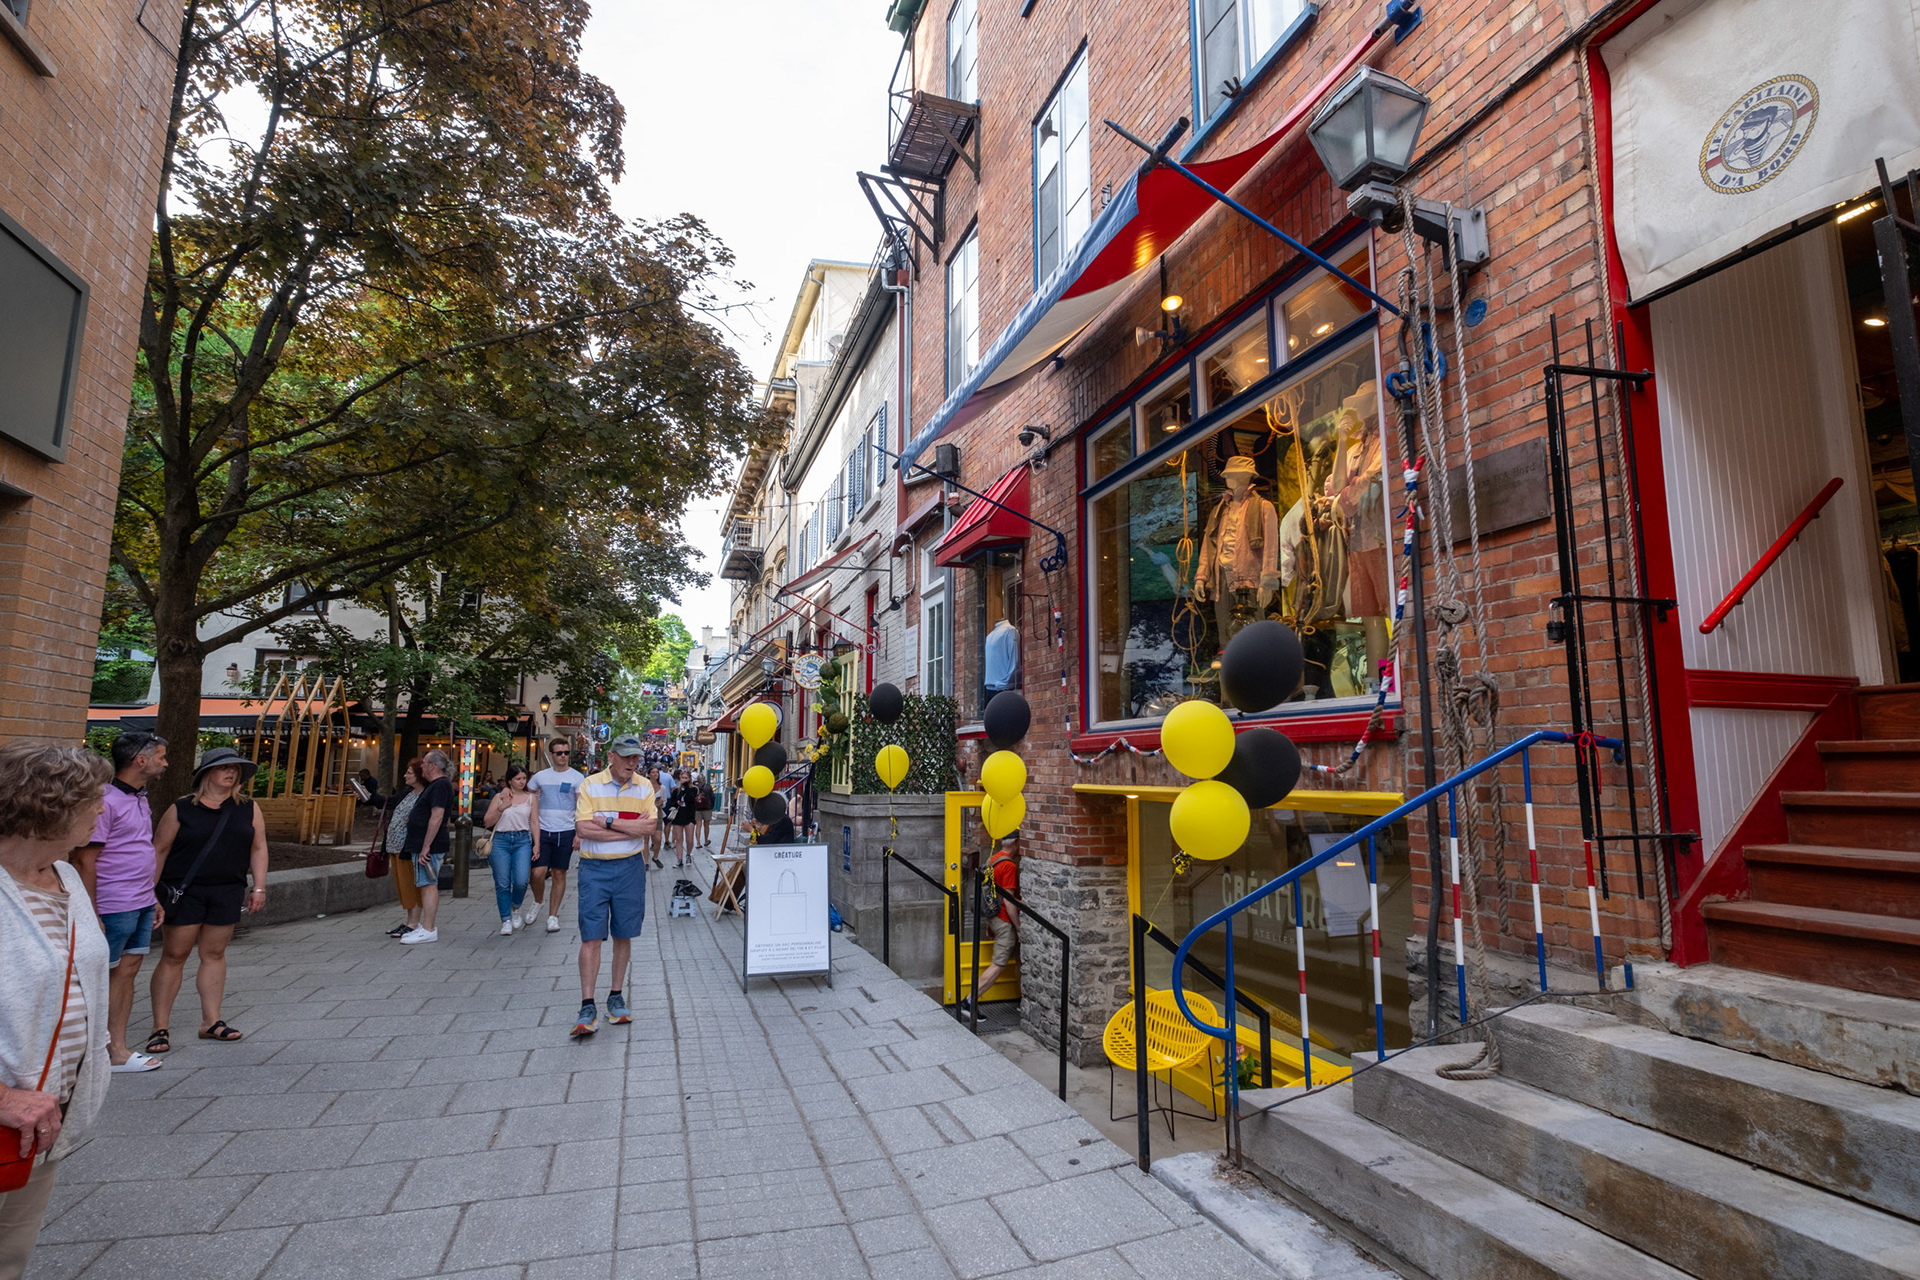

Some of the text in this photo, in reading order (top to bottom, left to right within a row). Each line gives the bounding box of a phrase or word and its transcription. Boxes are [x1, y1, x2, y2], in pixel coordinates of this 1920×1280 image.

[1709, 84, 1809, 156] LE CAPITAINE
[1757, 132, 1802, 182] BORD
[567, 717, 582, 725] LAPIN
[1254, 928, 1296, 947] ATELIER
